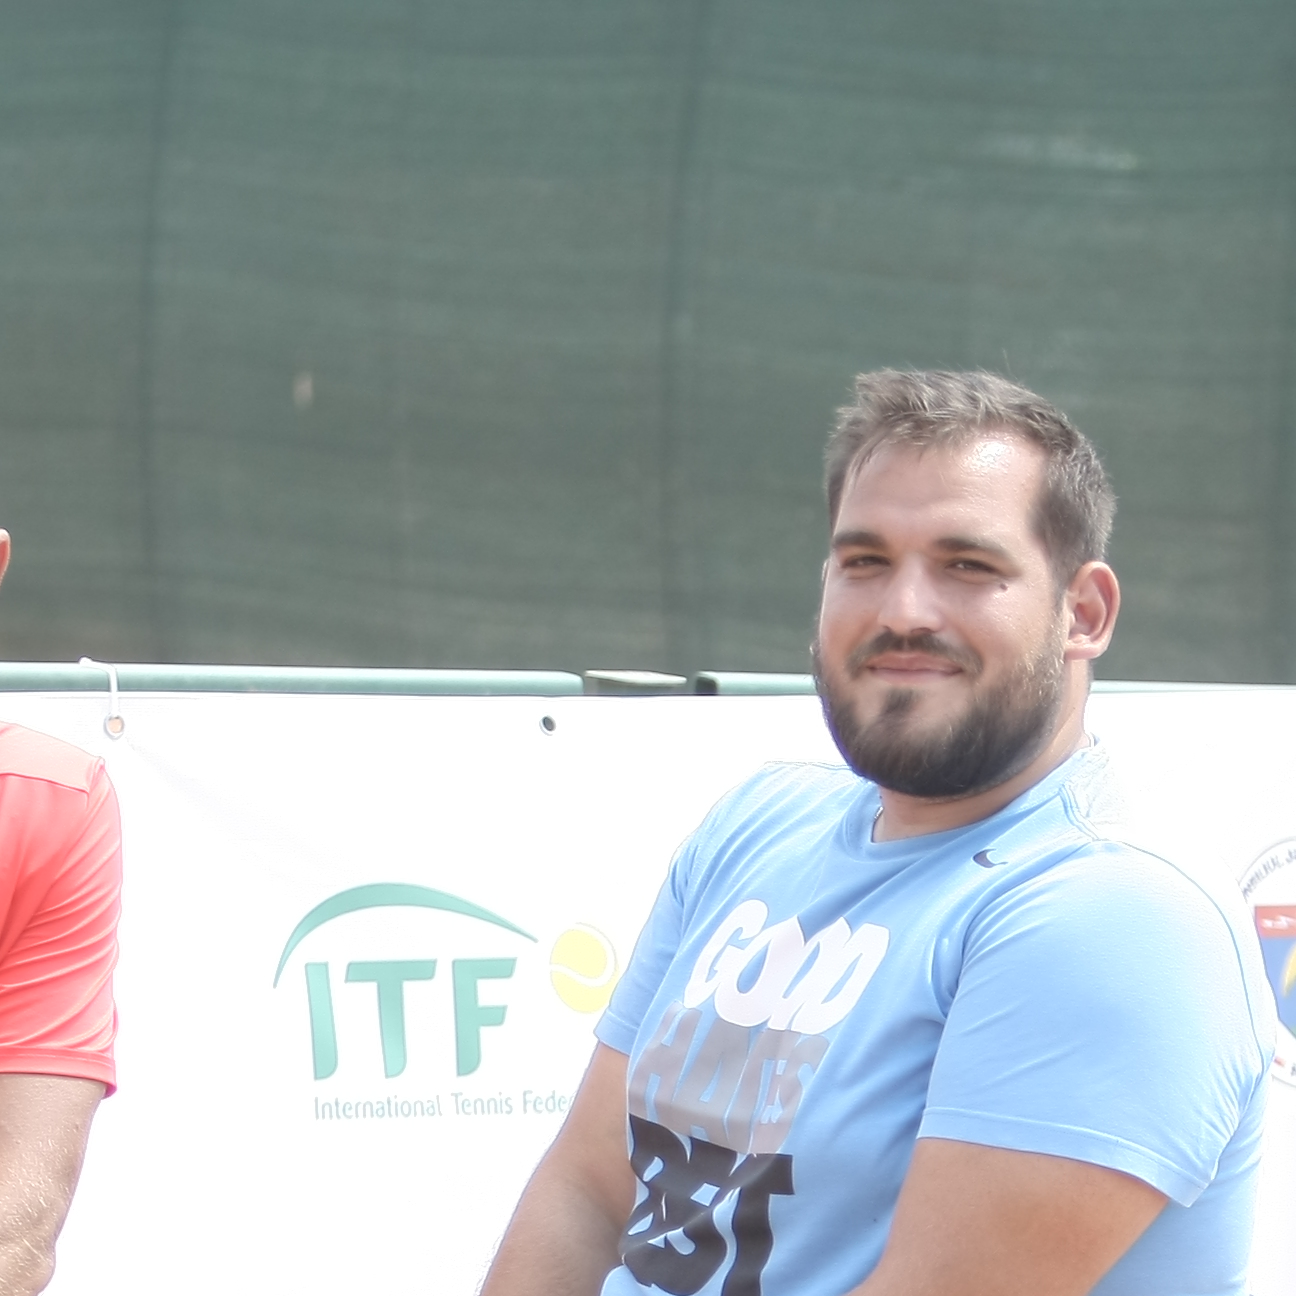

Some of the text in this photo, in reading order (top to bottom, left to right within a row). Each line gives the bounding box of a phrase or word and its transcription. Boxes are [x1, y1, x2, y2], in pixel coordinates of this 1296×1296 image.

[304, 956, 517, 1081] ITF
[683, 899, 891, 1035] GOOD
[314, 1095, 443, 1121] International
[450, 1091, 514, 1116] Tennis
